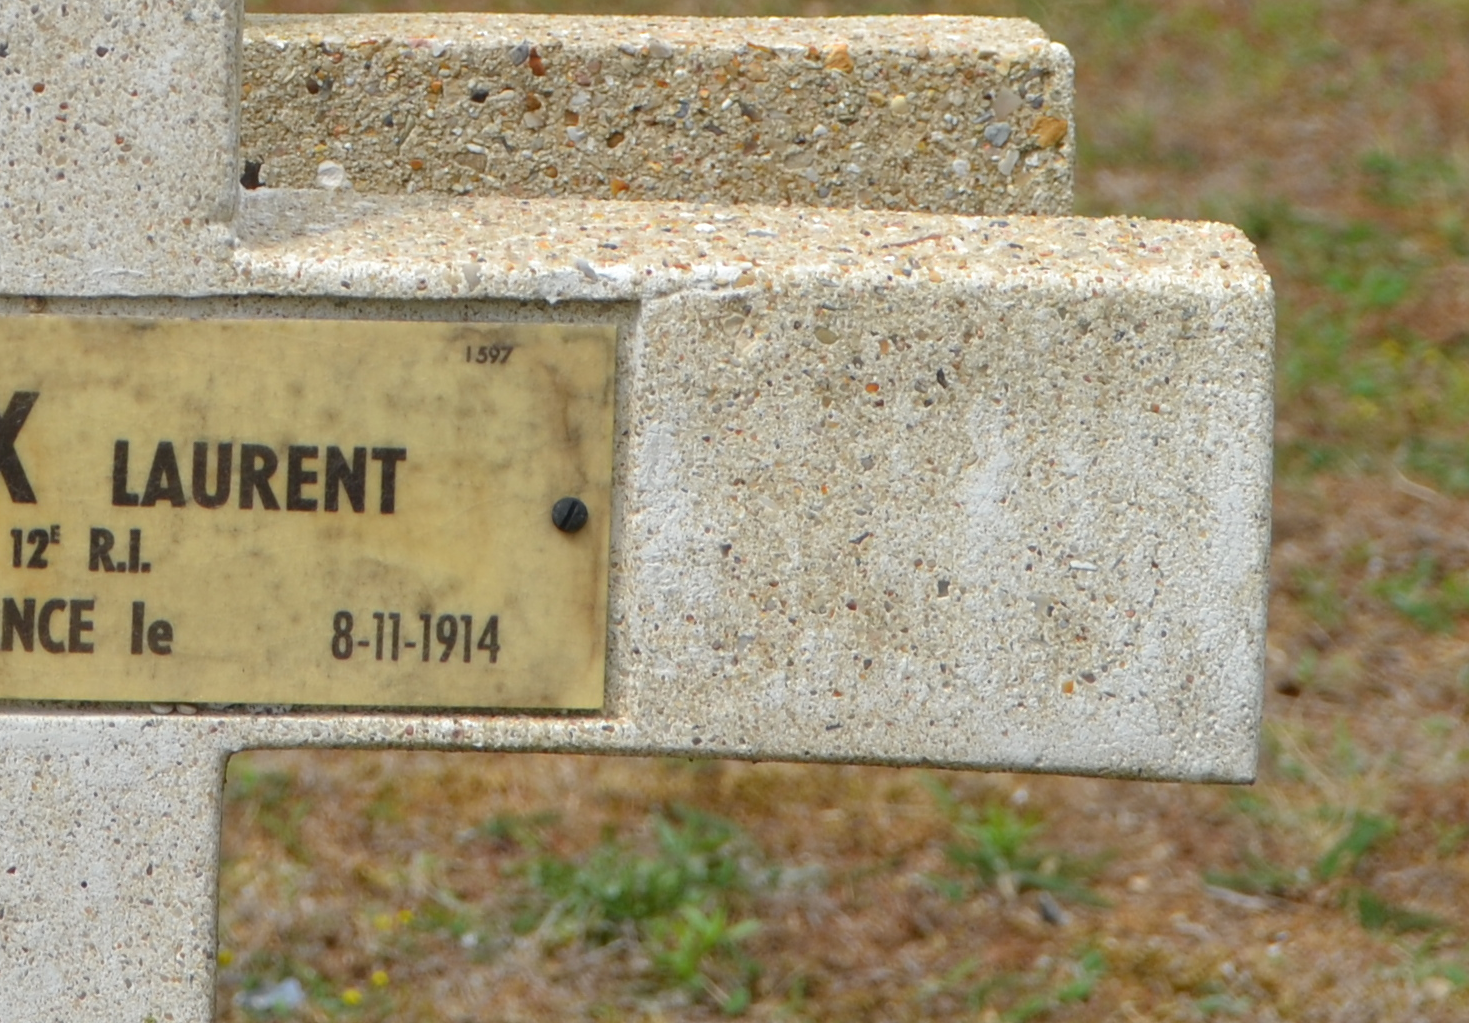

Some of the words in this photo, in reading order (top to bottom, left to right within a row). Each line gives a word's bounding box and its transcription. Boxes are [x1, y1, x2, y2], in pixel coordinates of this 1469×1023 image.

[465, 344, 514, 364] 1597
[111, 439, 408, 515] LAURENT
[88, 526, 152, 573] R.I.
[331, 610, 500, 663] 8-11-1914
